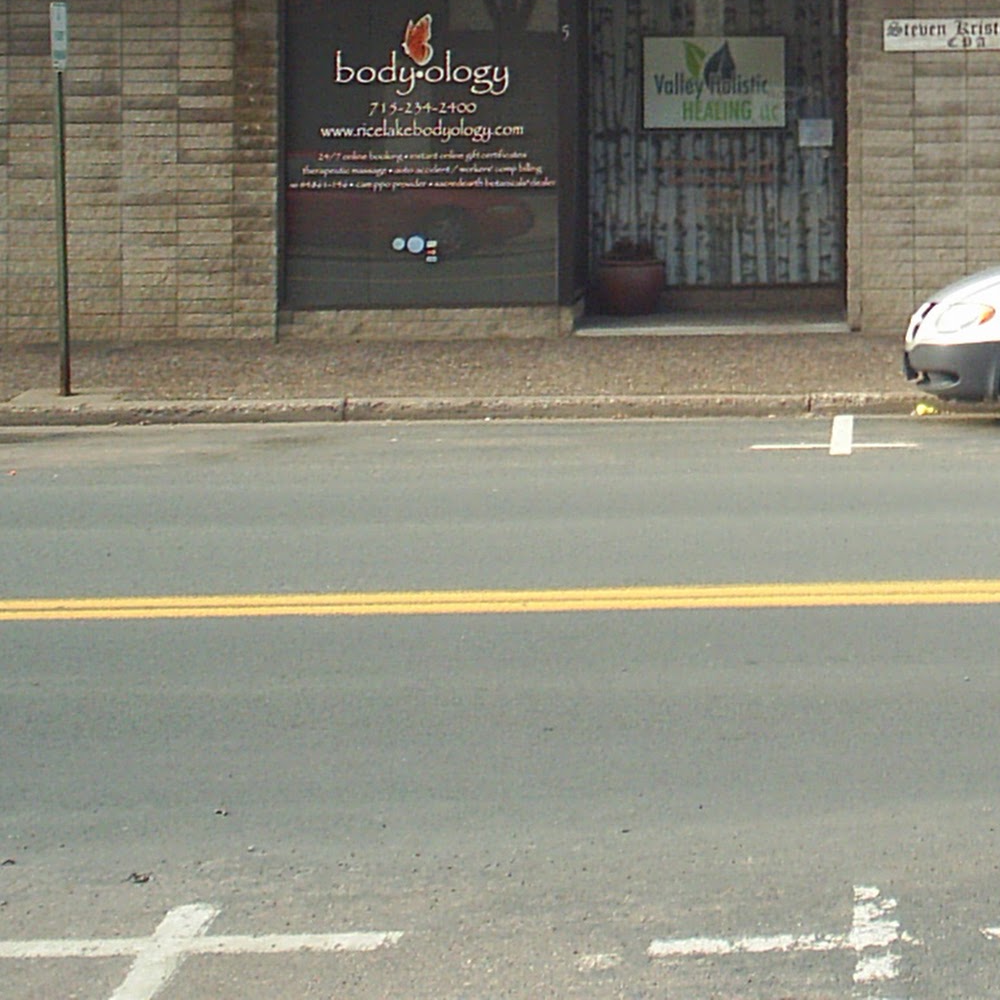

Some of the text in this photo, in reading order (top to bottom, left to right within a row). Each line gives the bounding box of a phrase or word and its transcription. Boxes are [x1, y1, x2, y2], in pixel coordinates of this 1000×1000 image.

[887, 21, 946, 38] Steven
[654, 71, 769, 99] Valley Holistic
[368, 102, 477, 116] 715-234-2400
[682, 100, 752, 121] HEALING
[320, 118, 524, 143] www.ricelakebodyology.com
